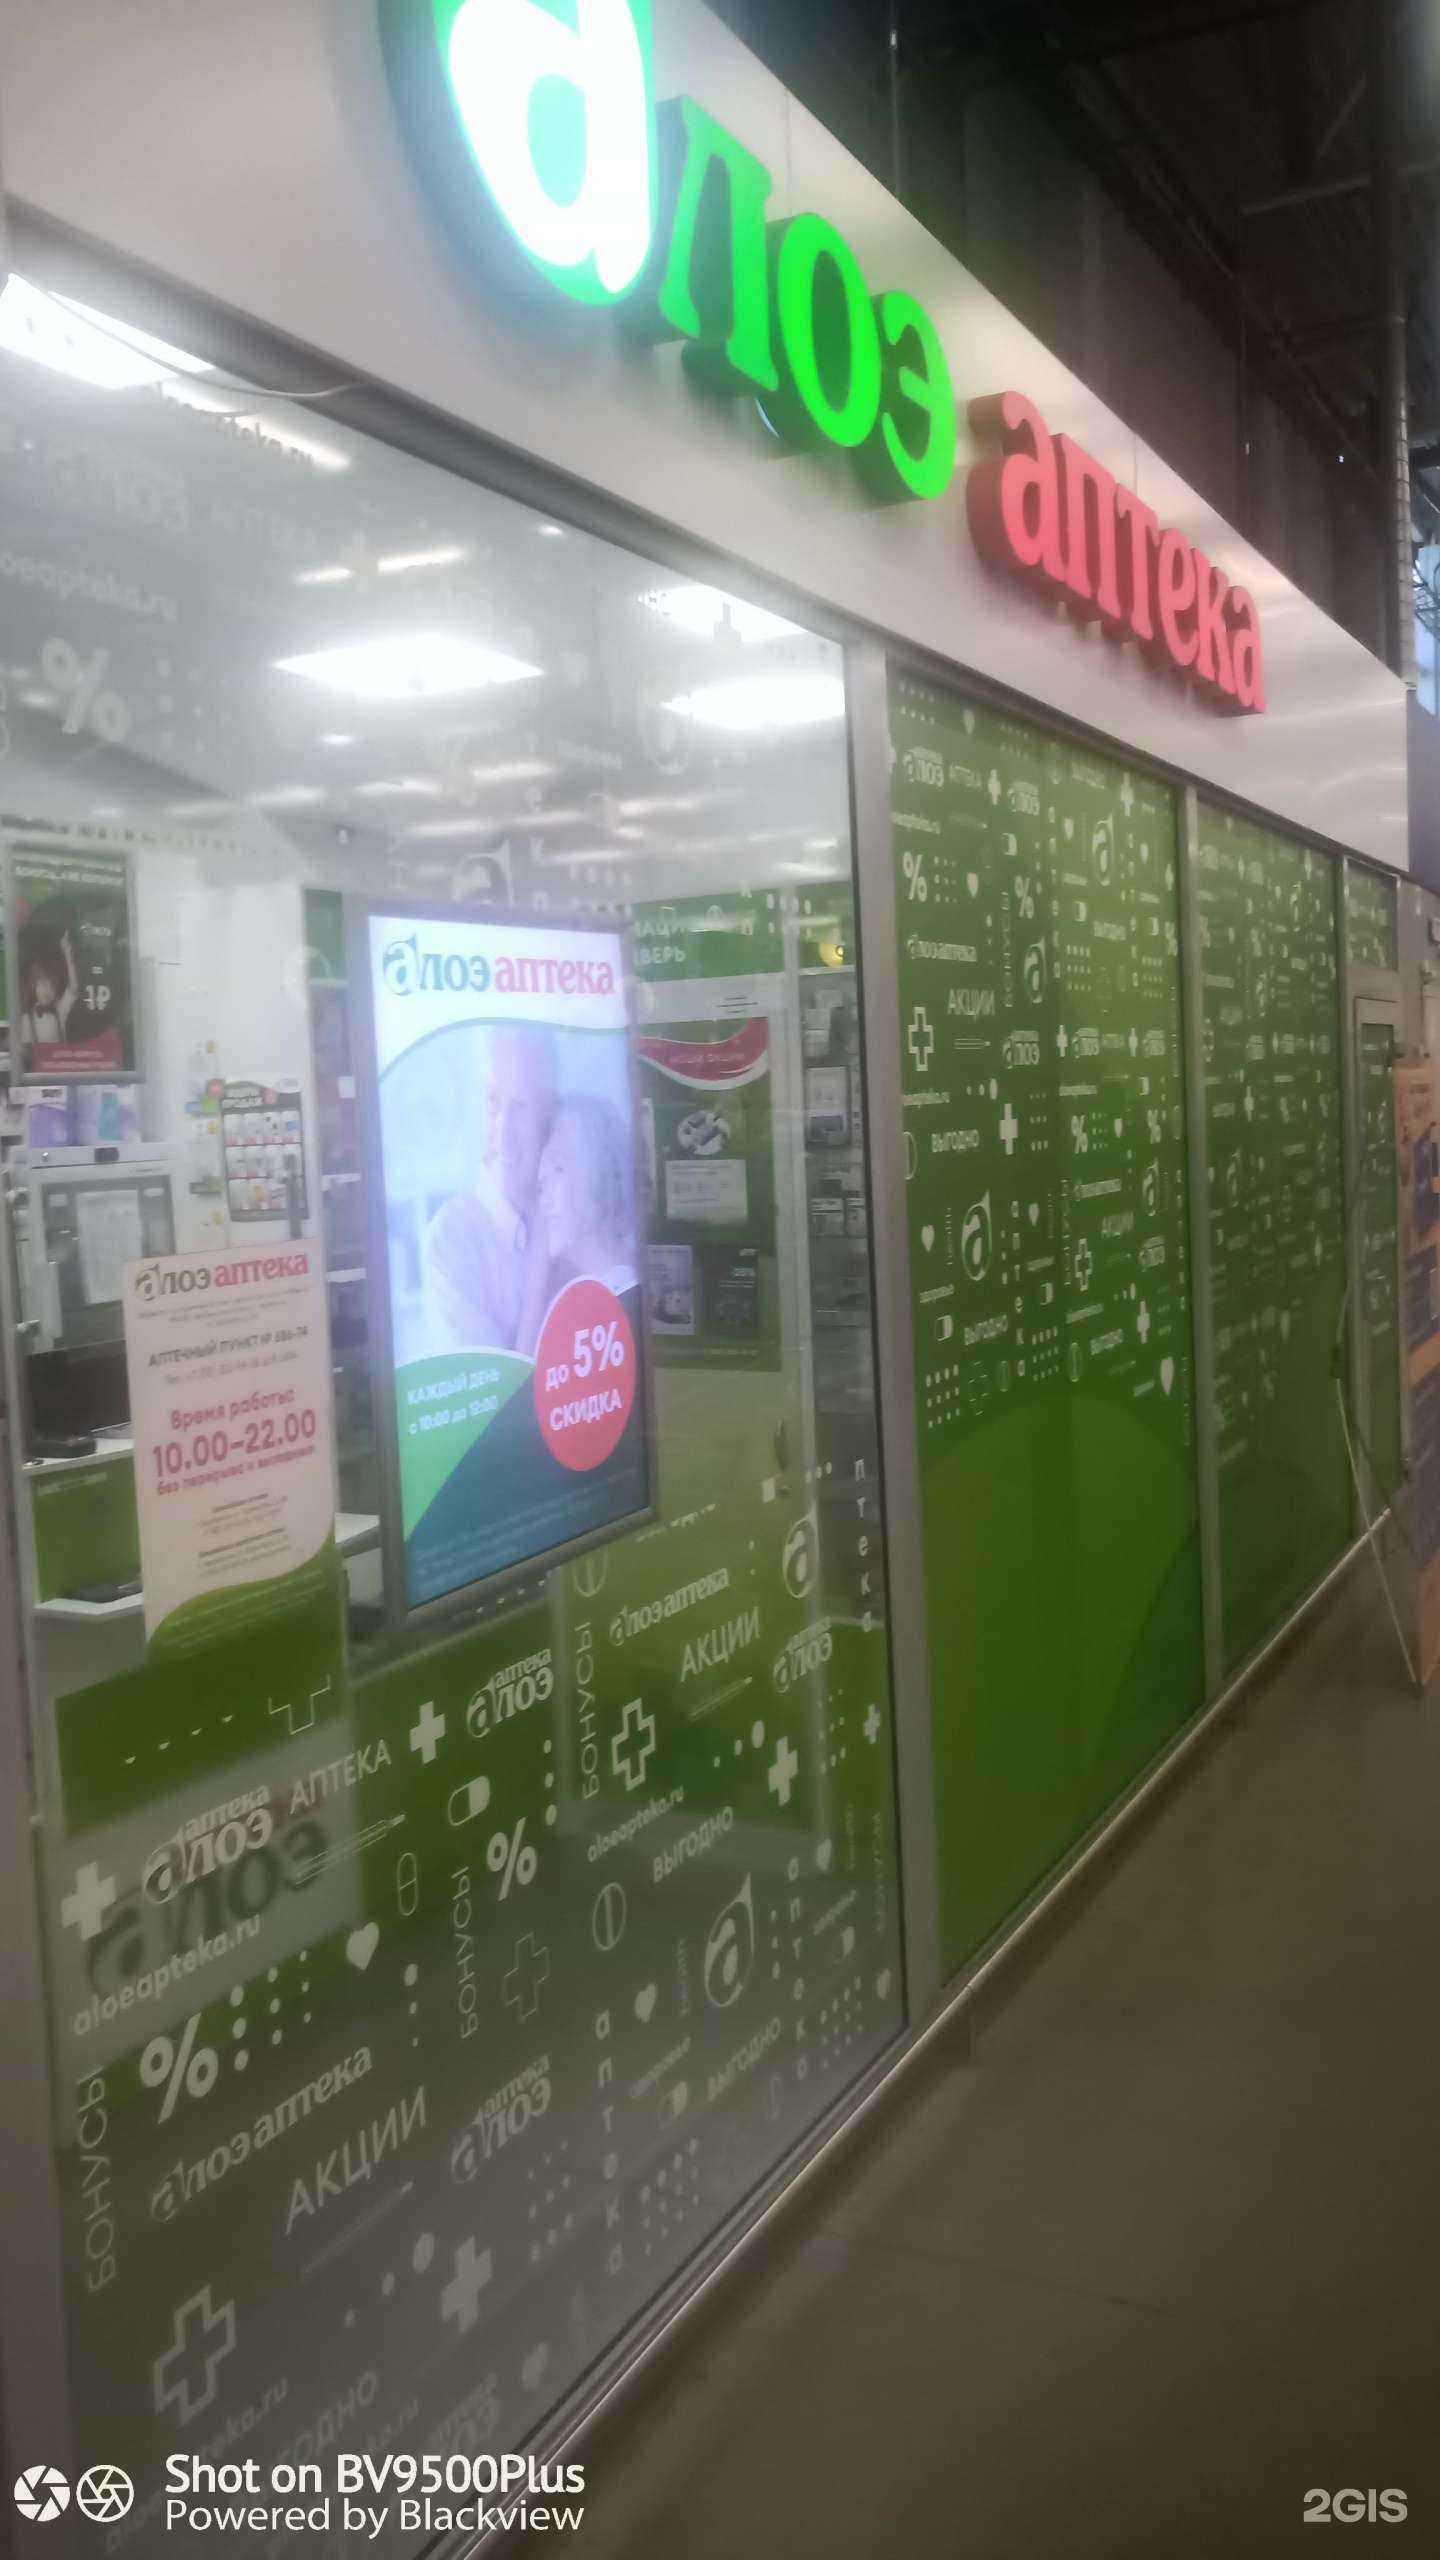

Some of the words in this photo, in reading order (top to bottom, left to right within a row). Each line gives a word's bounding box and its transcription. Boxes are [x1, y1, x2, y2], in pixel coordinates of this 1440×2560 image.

[998, 390, 1267, 713] аптека
[947, 987, 996, 1020] АКЦИИ
[544, 1366, 570, 1392] до
[572, 1320, 626, 1379] 5%
[151, 1408, 317, 1478] 10.00-22.00
[549, 1388, 624, 1432] СКИДКА
[680, 1605, 761, 1683] АКЦИИ
[289, 1738, 393, 1815] АПТЕКА
[653, 1805, 735, 1884] ВЫГОДНО
[73, 1911, 262, 2036] aloeapteka.ru
[451, 1866, 479, 2039] БОНУСЫ
[75, 2065, 117, 2293] БОНУСЫ
[284, 2085, 428, 2236] АКЦИИ
